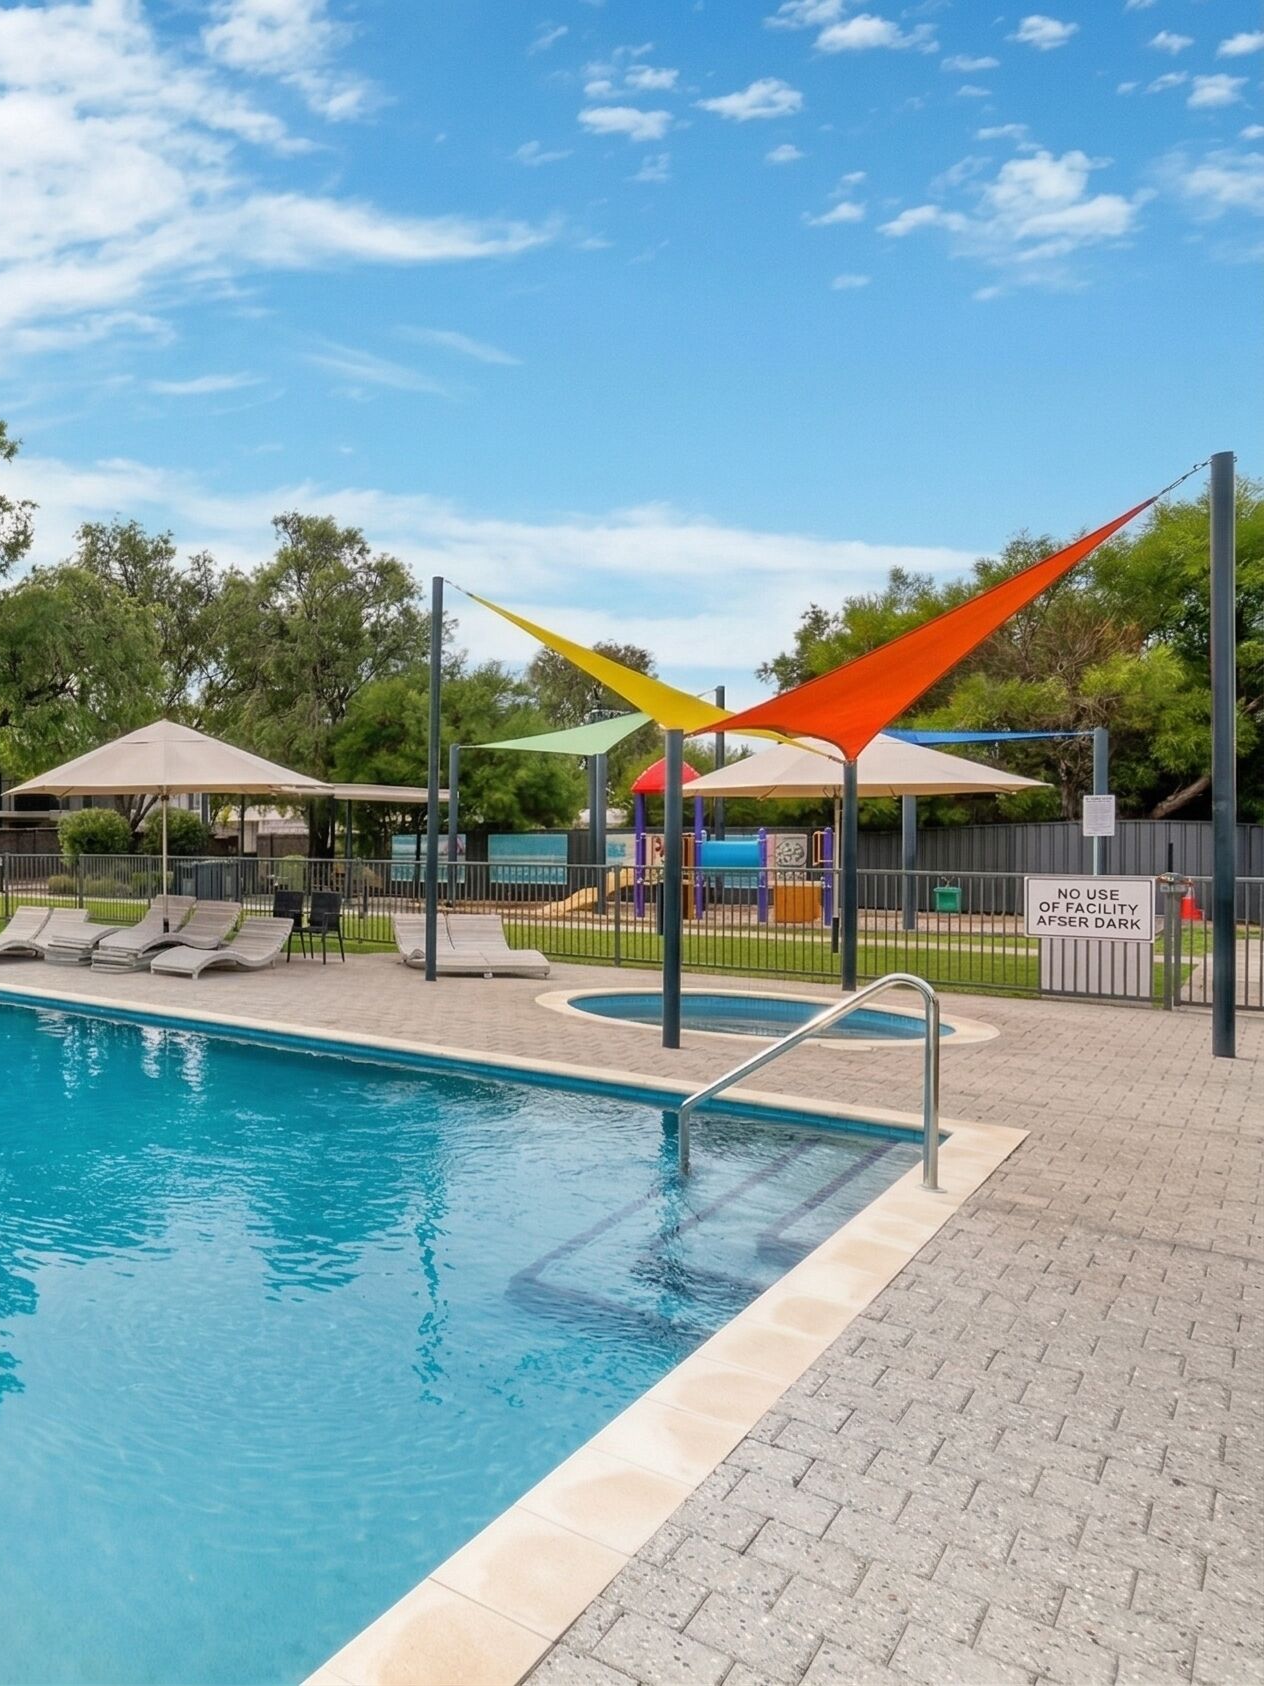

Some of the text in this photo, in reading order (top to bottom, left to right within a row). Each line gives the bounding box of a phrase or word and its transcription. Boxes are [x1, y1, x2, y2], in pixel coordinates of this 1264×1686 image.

[1058, 888, 1120, 901] NO USE
[1039, 901, 1139, 916] OF FACILITY
[1036, 915, 1141, 930] AFSER DARK
